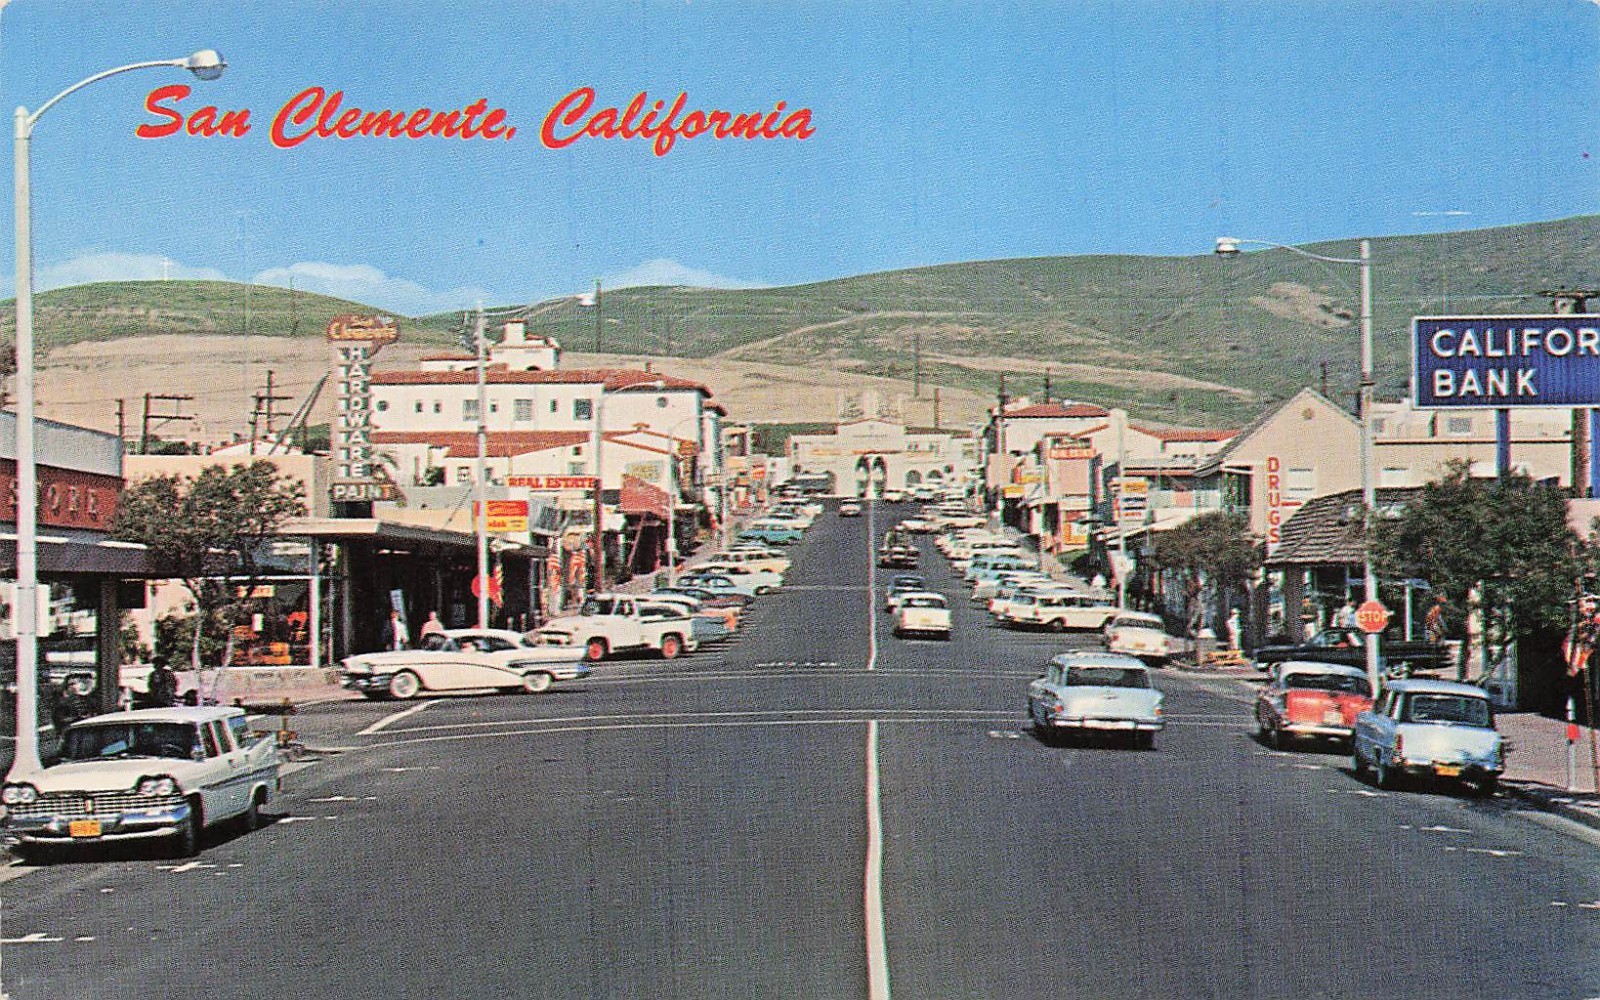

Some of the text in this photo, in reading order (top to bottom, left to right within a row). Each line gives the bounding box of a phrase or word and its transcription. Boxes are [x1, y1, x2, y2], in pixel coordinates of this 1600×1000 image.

[1433, 368, 1539, 397] BANK
[348, 346, 367, 477] HARDWARE
[333, 484, 392, 499] PAINT
[508, 477, 595, 489] REAL ESTATE
[1266, 456, 1280, 544] DRUGS
[1357, 610, 1388, 622] STOP
